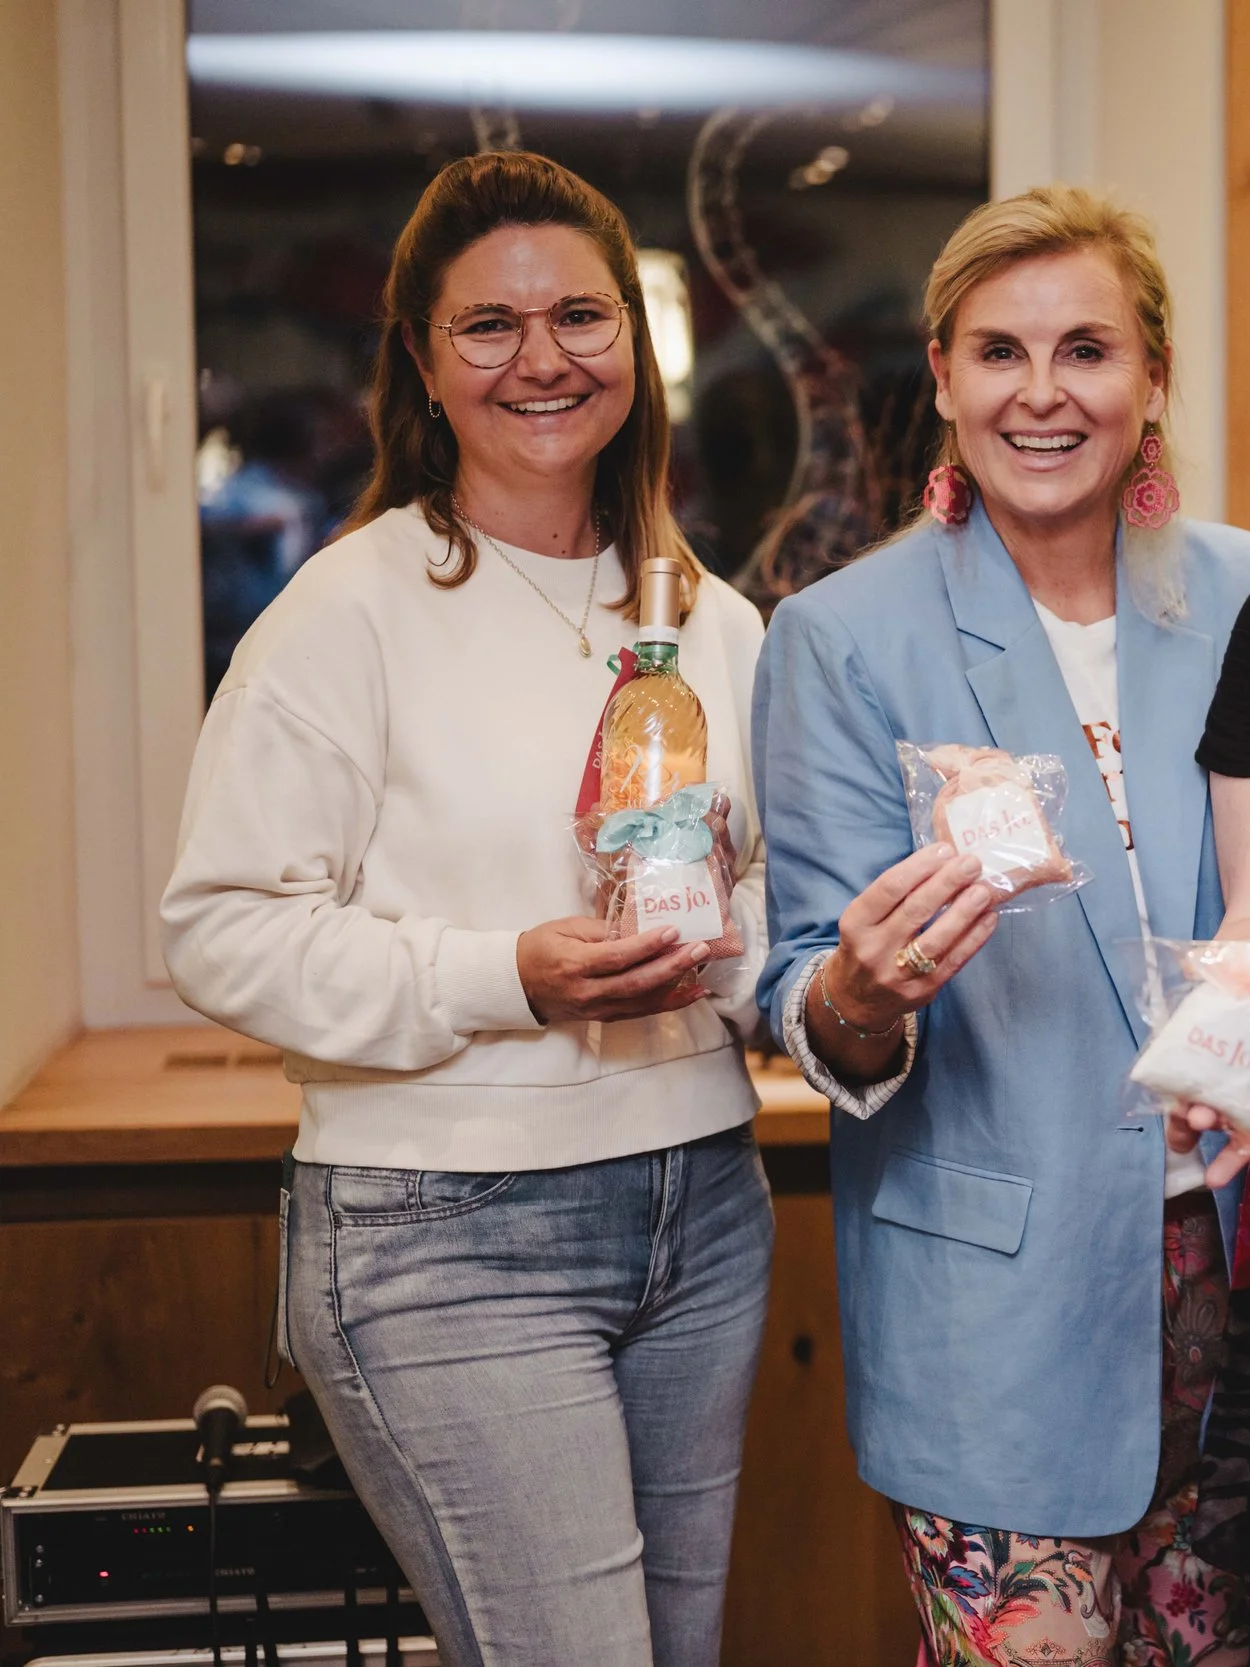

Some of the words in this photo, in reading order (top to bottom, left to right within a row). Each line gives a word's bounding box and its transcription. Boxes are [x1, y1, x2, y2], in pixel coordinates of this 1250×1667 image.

[962, 820, 1000, 847] DAS
[643, 894, 681, 914] DAS
[1187, 1025, 1228, 1058] DAS
